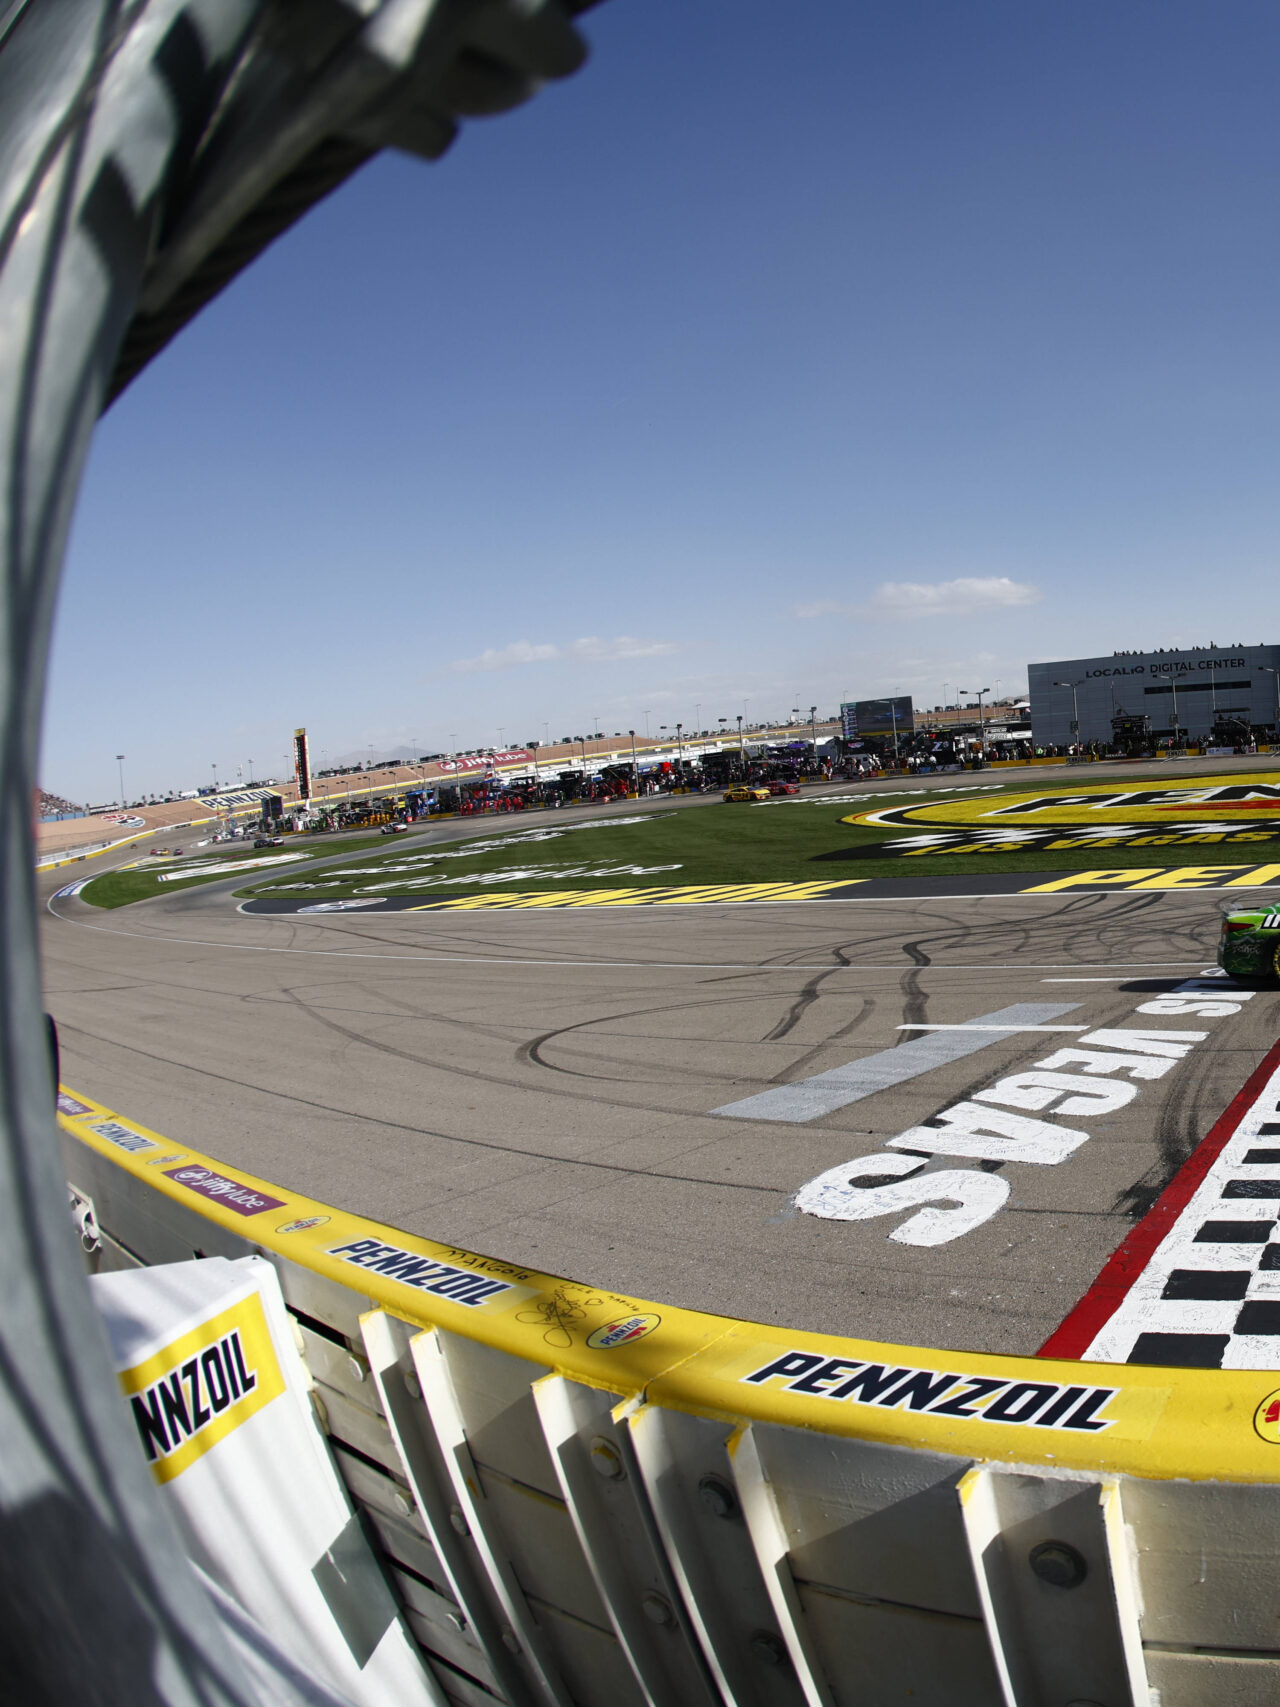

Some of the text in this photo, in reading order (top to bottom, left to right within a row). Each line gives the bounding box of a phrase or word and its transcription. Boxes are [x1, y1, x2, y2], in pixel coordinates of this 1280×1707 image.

[1150, 660, 1195, 674] DIGITAL
[1198, 658, 1246, 670] CENTER
[495, 753, 528, 762] lube
[201, 789, 276, 809] PENNZOIL
[901, 831, 1280, 857] LAS VEGAS
[793, 979, 1257, 1247] AS VEGAS
[88, 1123, 157, 1152] PENNZOIL
[191, 1177, 265, 1208] jiffy lube
[284, 1217, 320, 1232] PENNZOIL
[329, 1239, 515, 1307] PENNZOIL
[600, 1316, 649, 1346] PENNZOIL
[131, 1330, 257, 1461] NNZOIL
[747, 1351, 1117, 1432] PENNZOIL
